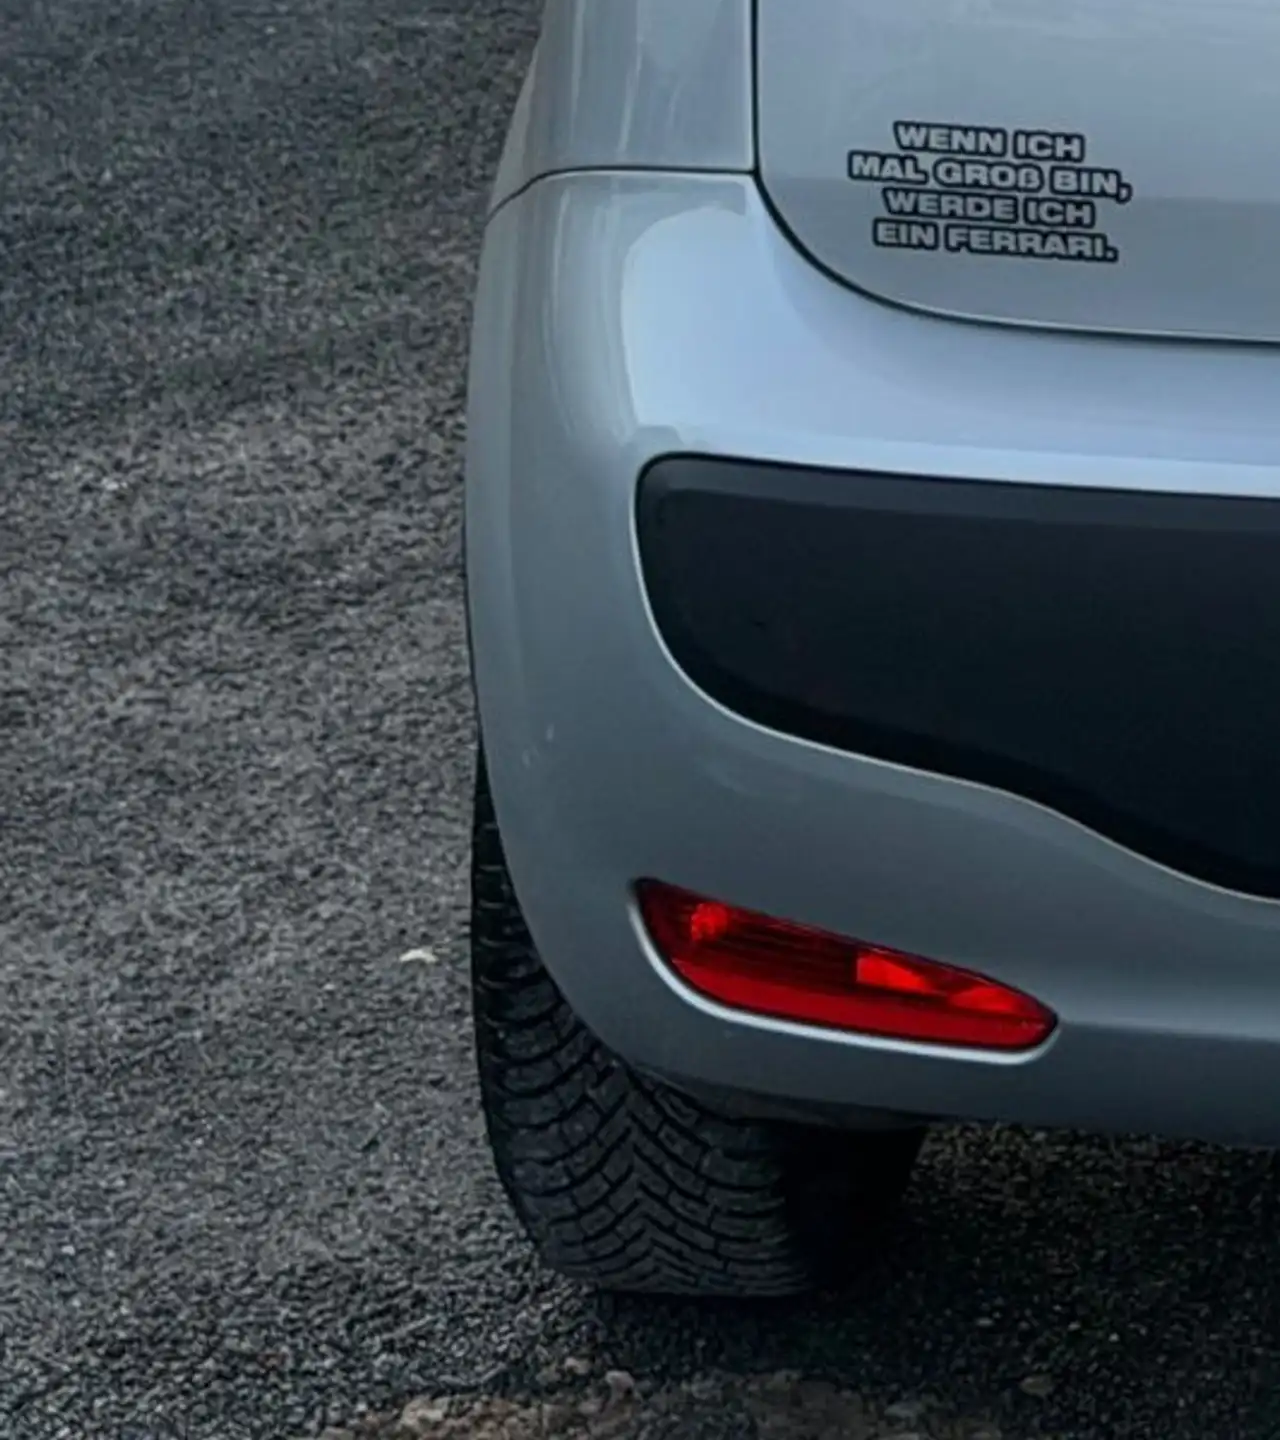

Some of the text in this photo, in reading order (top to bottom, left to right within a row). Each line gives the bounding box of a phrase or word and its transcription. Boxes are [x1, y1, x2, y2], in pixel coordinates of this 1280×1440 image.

[896, 123, 1085, 161] WENN ICH
[850, 153, 928, 185] MAL
[1050, 167, 1133, 203] BIN,
[884, 190, 1096, 228] WERDE ICH
[874, 220, 1119, 262] EIN FERRARI.
